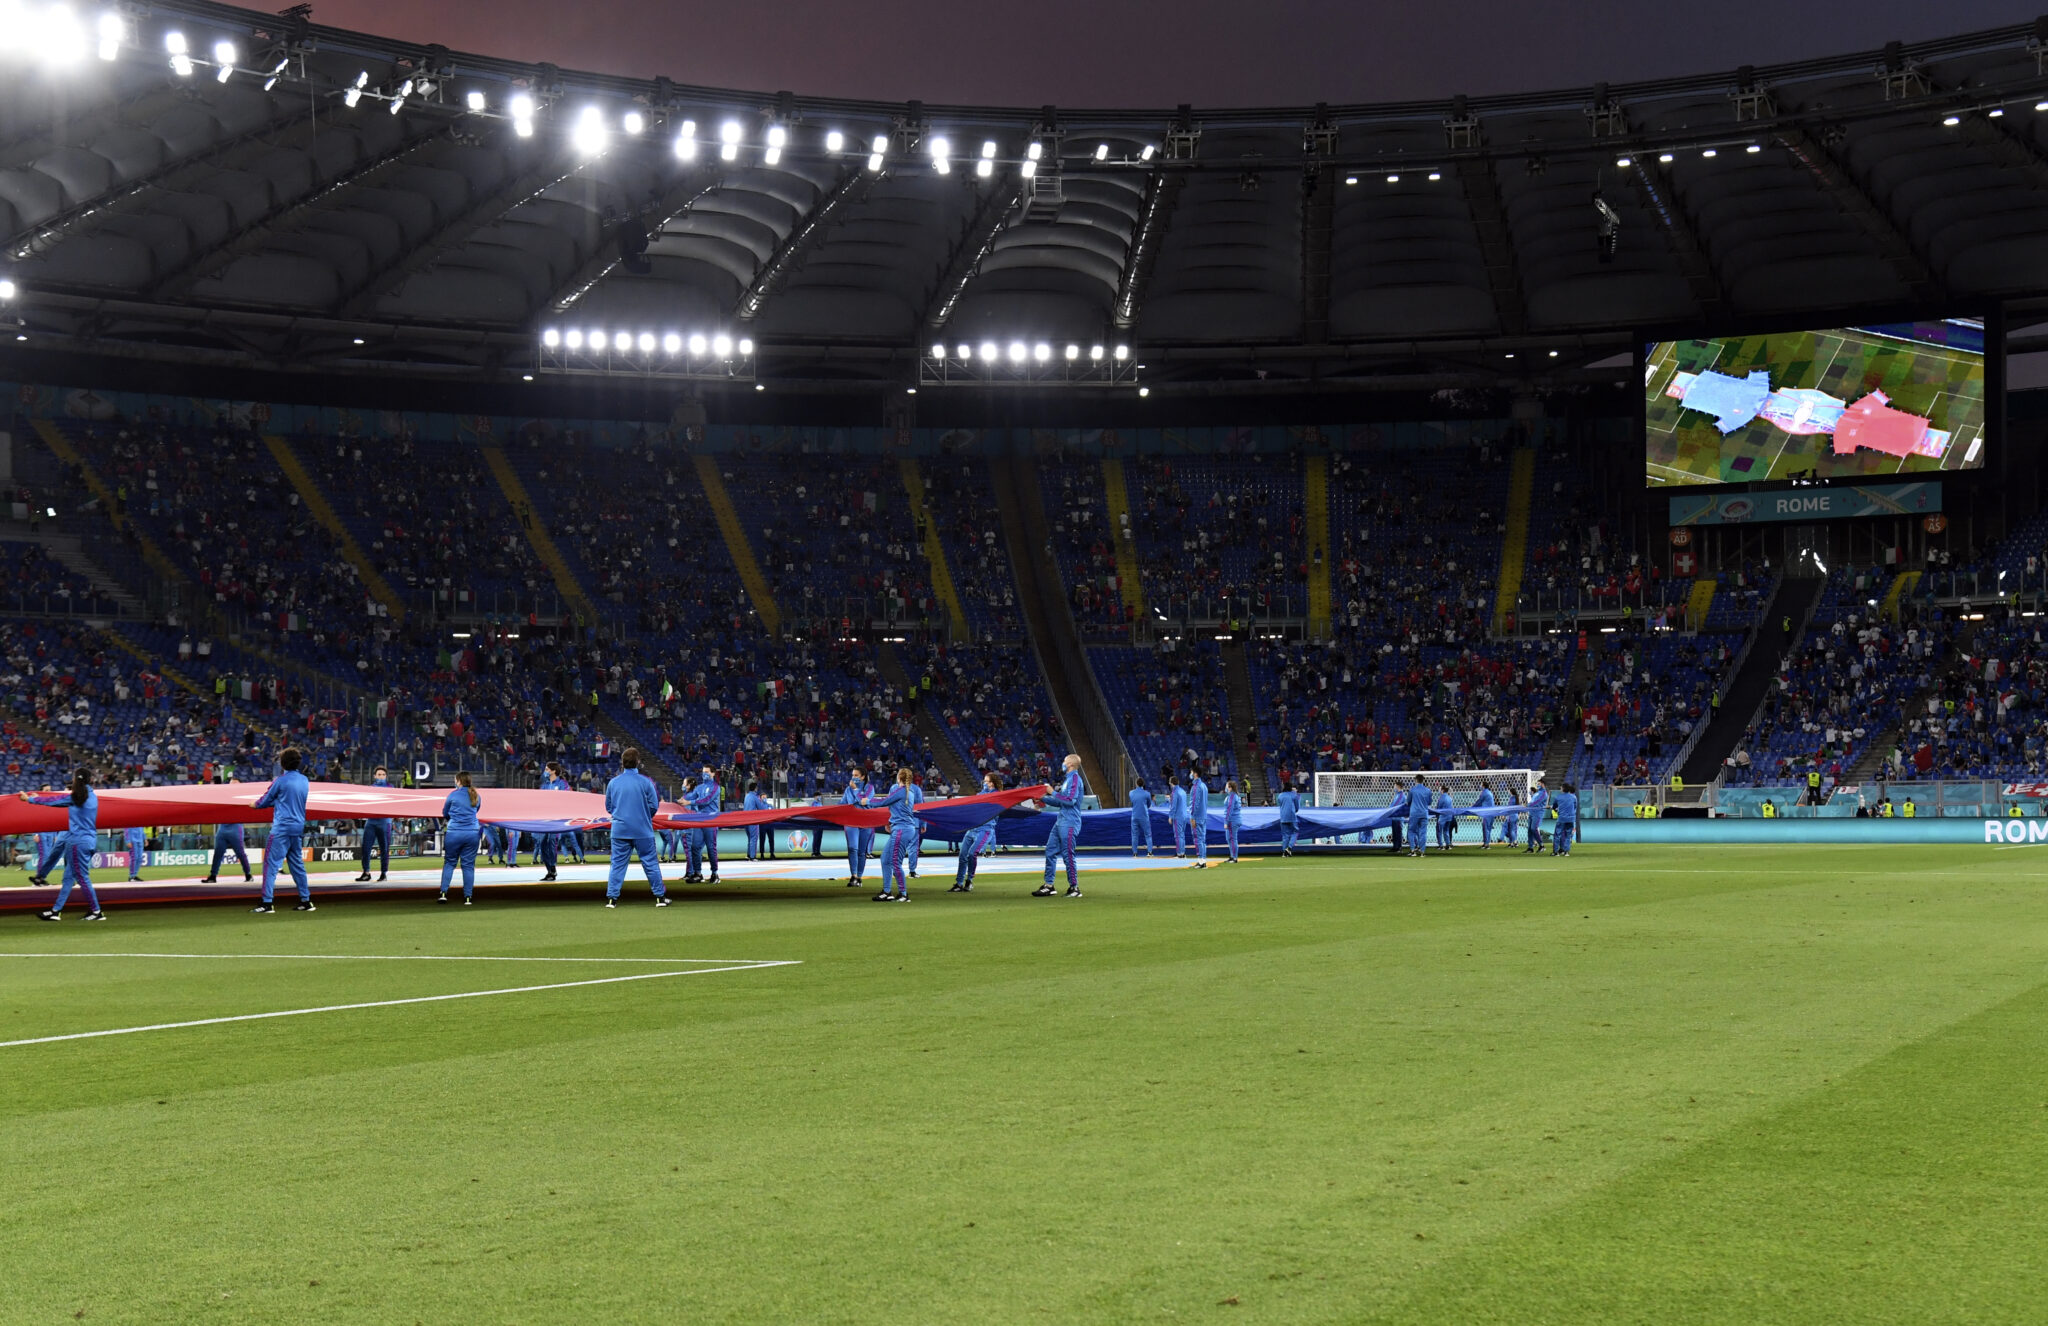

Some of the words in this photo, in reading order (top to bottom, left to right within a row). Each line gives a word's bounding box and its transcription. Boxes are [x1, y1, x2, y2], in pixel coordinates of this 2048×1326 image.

[1776, 496, 1830, 513] ROME
[1928, 521, 1941, 531] AS
[1673, 535, 1687, 545] AD
[415, 761, 431, 780] D
[1985, 820, 2048, 843] ROM
[106, 853, 125, 867] The
[154, 851, 206, 866] Hisense
[330, 850, 354, 861] TikTok
